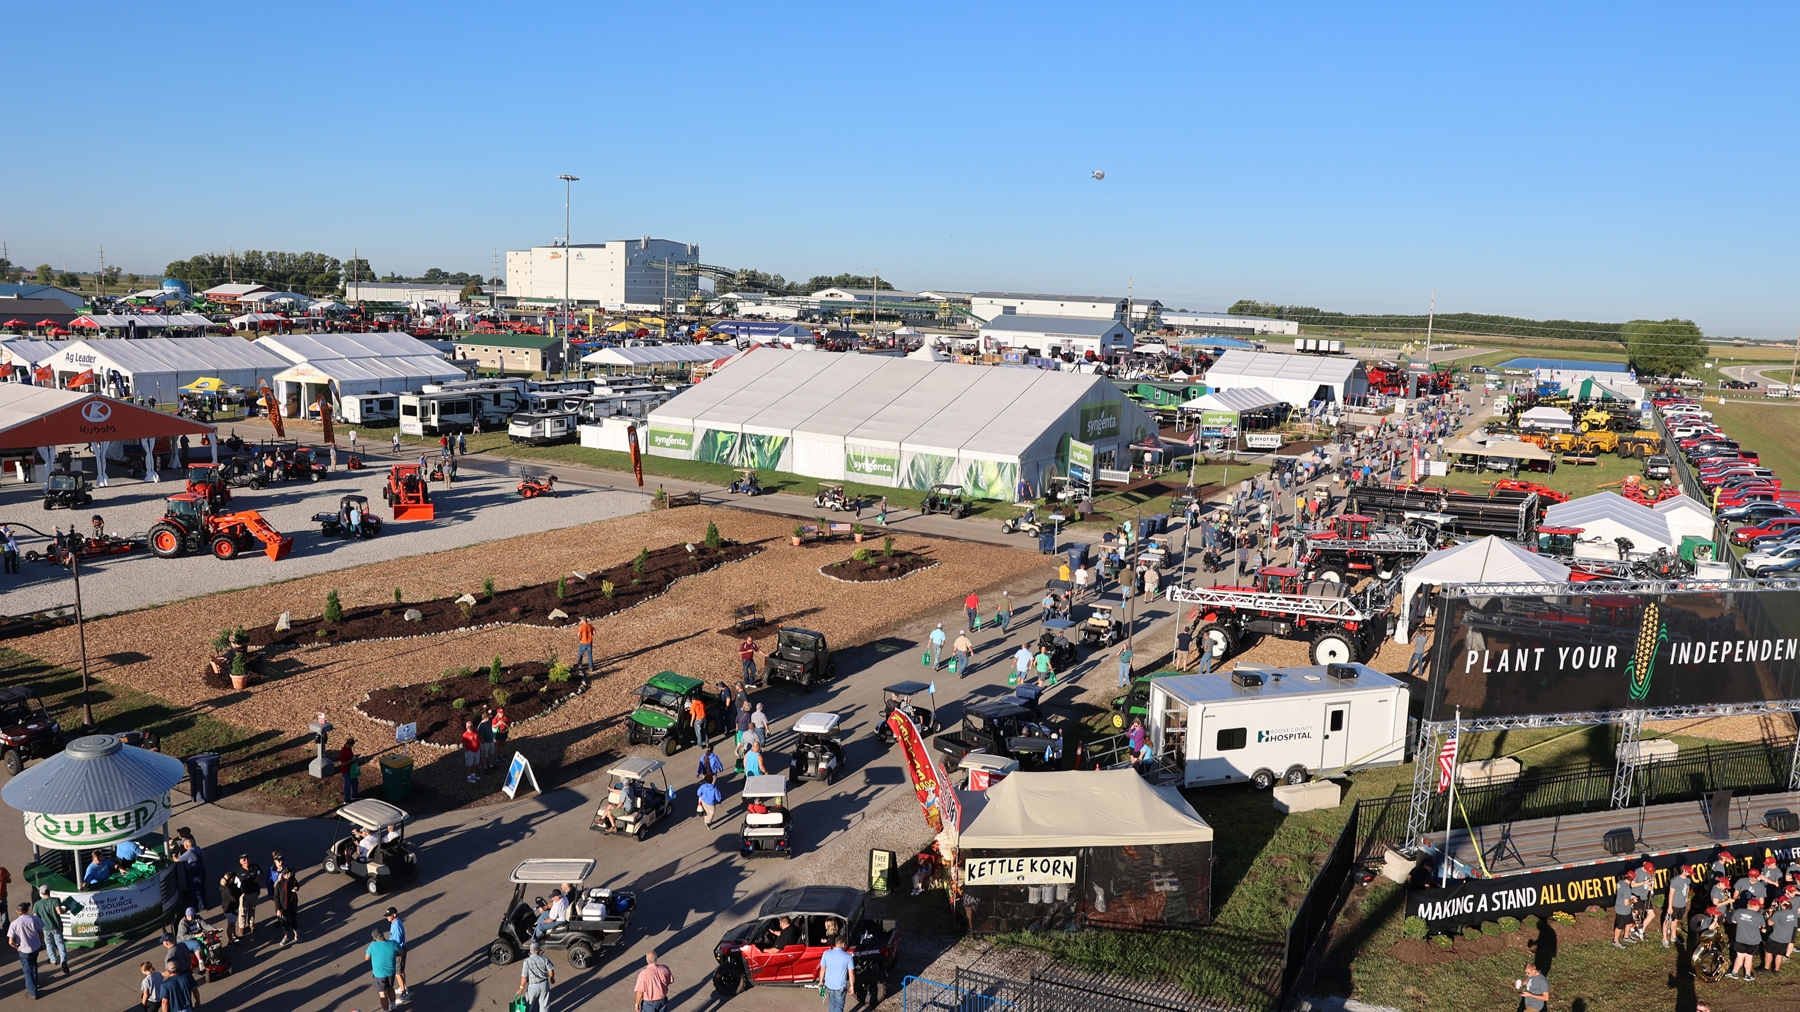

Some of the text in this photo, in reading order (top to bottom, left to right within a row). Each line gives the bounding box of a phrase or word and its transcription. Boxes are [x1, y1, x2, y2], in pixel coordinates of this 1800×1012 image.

[65, 352, 97, 363] Ag Leader
[79, 425, 117, 434] Kubota
[1465, 638, 1800, 674] PLANT YOUR INDEPENDEN
[1270, 732, 1312, 742] HOSPITAL
[43, 806, 149, 836] Sukup
[874, 855, 887, 863] FREE
[968, 858, 1074, 882] KETTLE KORN
[101, 898, 134, 911] SOURCE
[1417, 894, 1474, 921] MAKING
[1476, 893, 1488, 913] A
[1491, 886, 1537, 912] STAND
[1539, 884, 1566, 906] ALL
[1567, 878, 1603, 902] OVER
[105, 903, 140, 916] nutrients.
